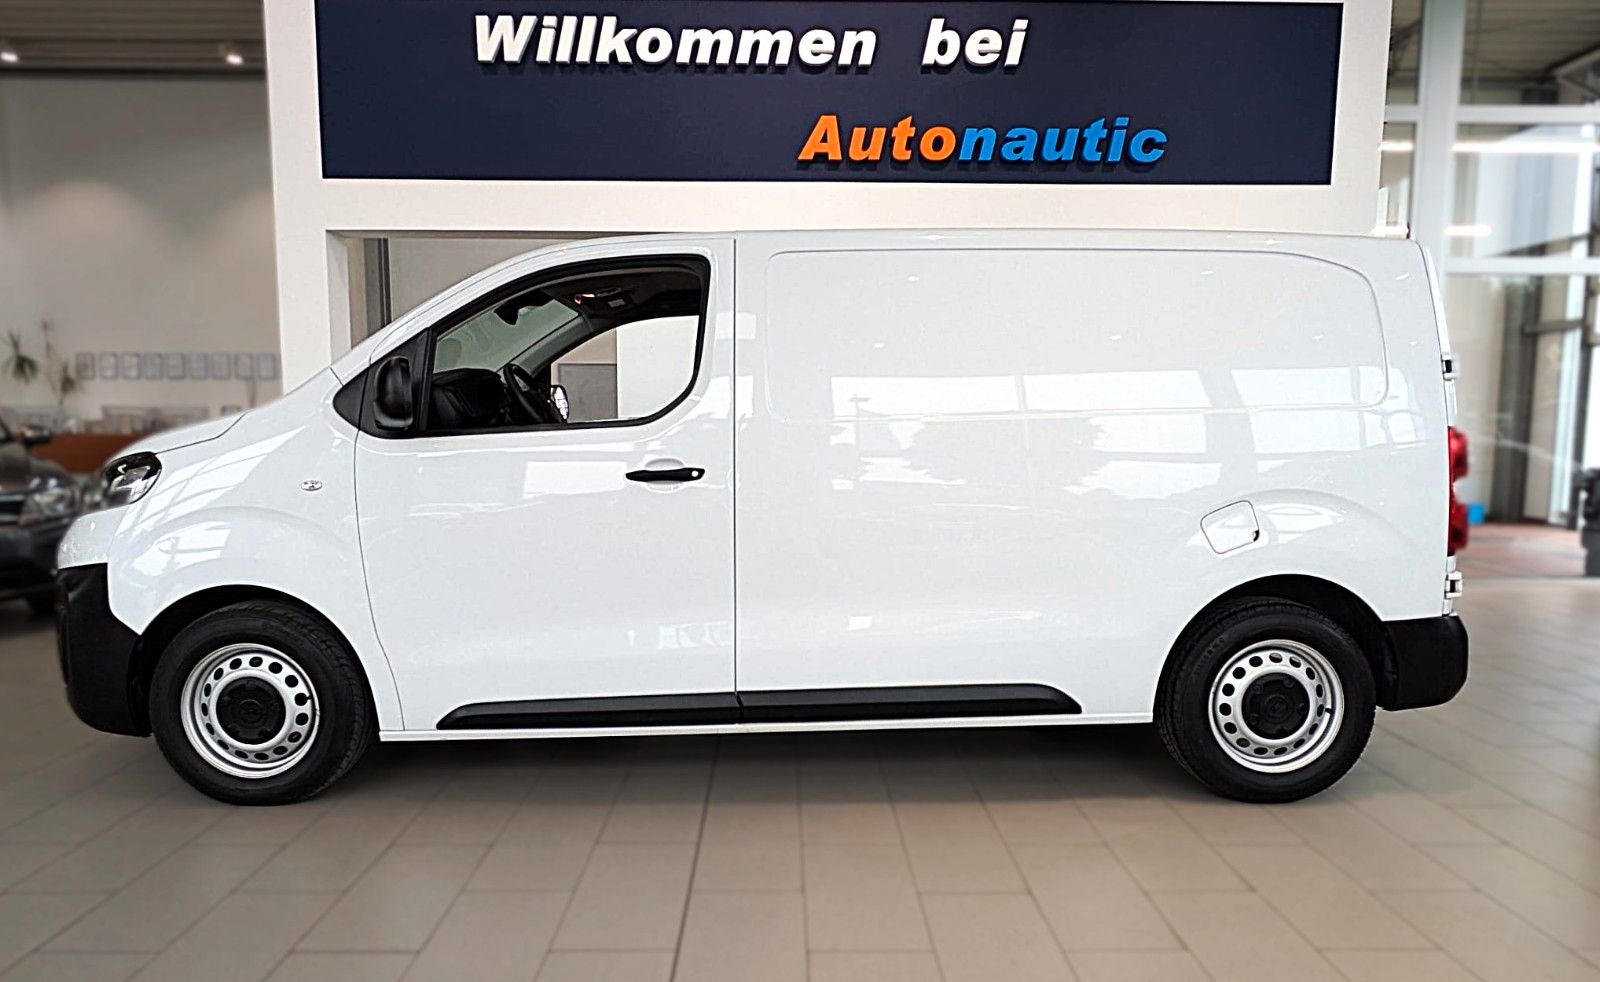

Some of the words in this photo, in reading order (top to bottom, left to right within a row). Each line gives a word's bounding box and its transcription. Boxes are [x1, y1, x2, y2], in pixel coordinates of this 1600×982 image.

[474, 14, 878, 66] Willkommen
[921, 17, 1029, 67] bei
[798, 114, 1168, 164] Autonautic
